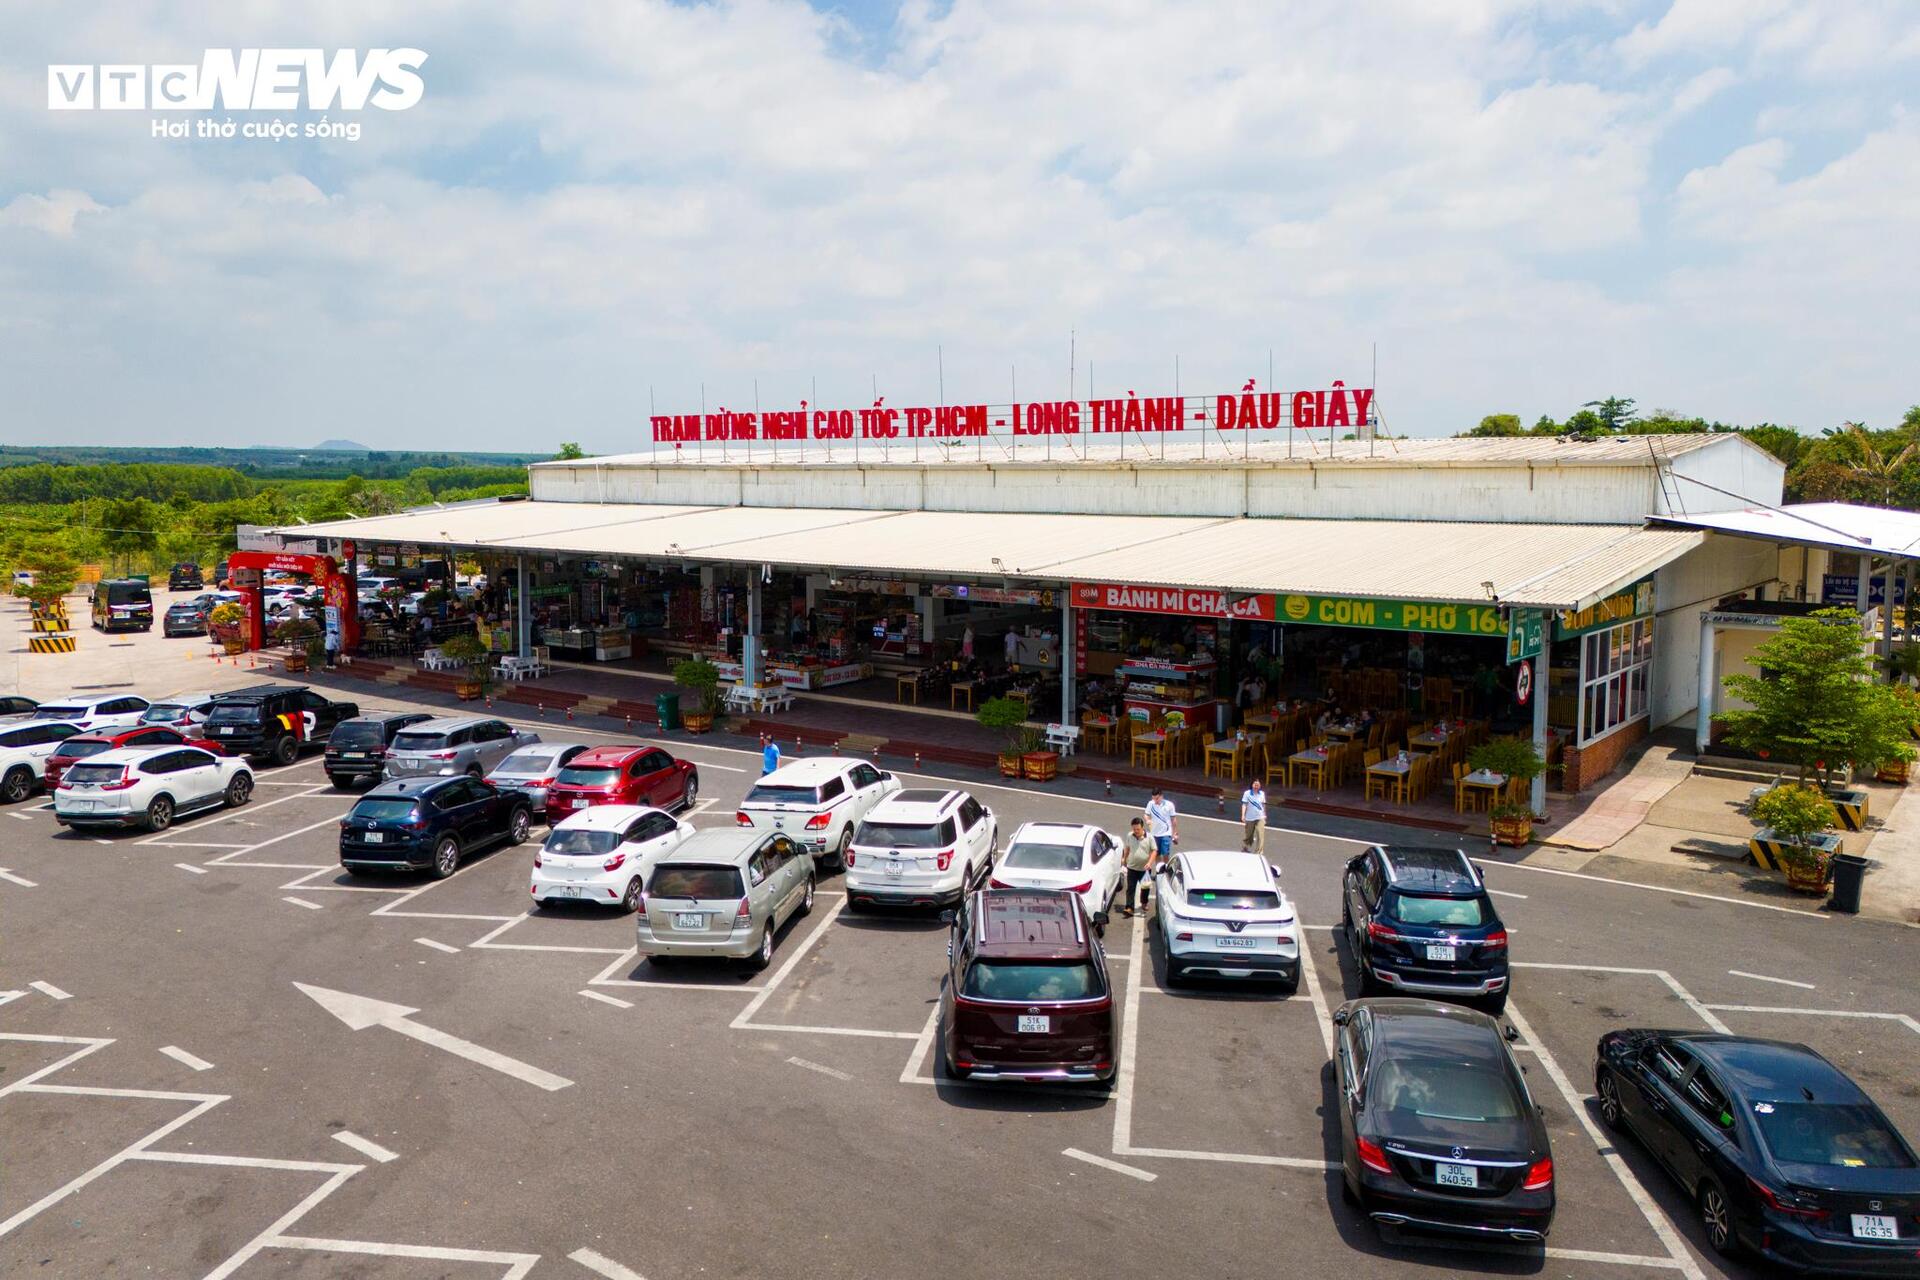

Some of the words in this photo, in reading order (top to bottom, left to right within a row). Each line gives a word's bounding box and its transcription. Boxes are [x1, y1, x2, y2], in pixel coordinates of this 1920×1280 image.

[650, 414, 702, 449] TRẠM
[705, 407, 758, 441] DỪNG
[762, 400, 808, 440] NGHỈ
[813, 410, 854, 440] CAO
[858, 397, 899, 439] TỐC
[903, 405, 988, 438] TP.HCM
[1012, 400, 1080, 436] LONG
[1088, 390, 1184, 433] THÀNH
[1293, 380, 1373, 429] GIÂY
[1107, 586, 1158, 609] BÁNH
[1162, 588, 1184, 611] MÌ
[1319, 599, 1374, 625] CƠM
[1027, 1016, 1040, 1024] 51K
[1447, 1165, 1465, 1175] 30L
[1440, 1174, 1473, 1186] 940.55
[1864, 1216, 1884, 1226] 71A
[1858, 1226, 1893, 1238] 146.35
